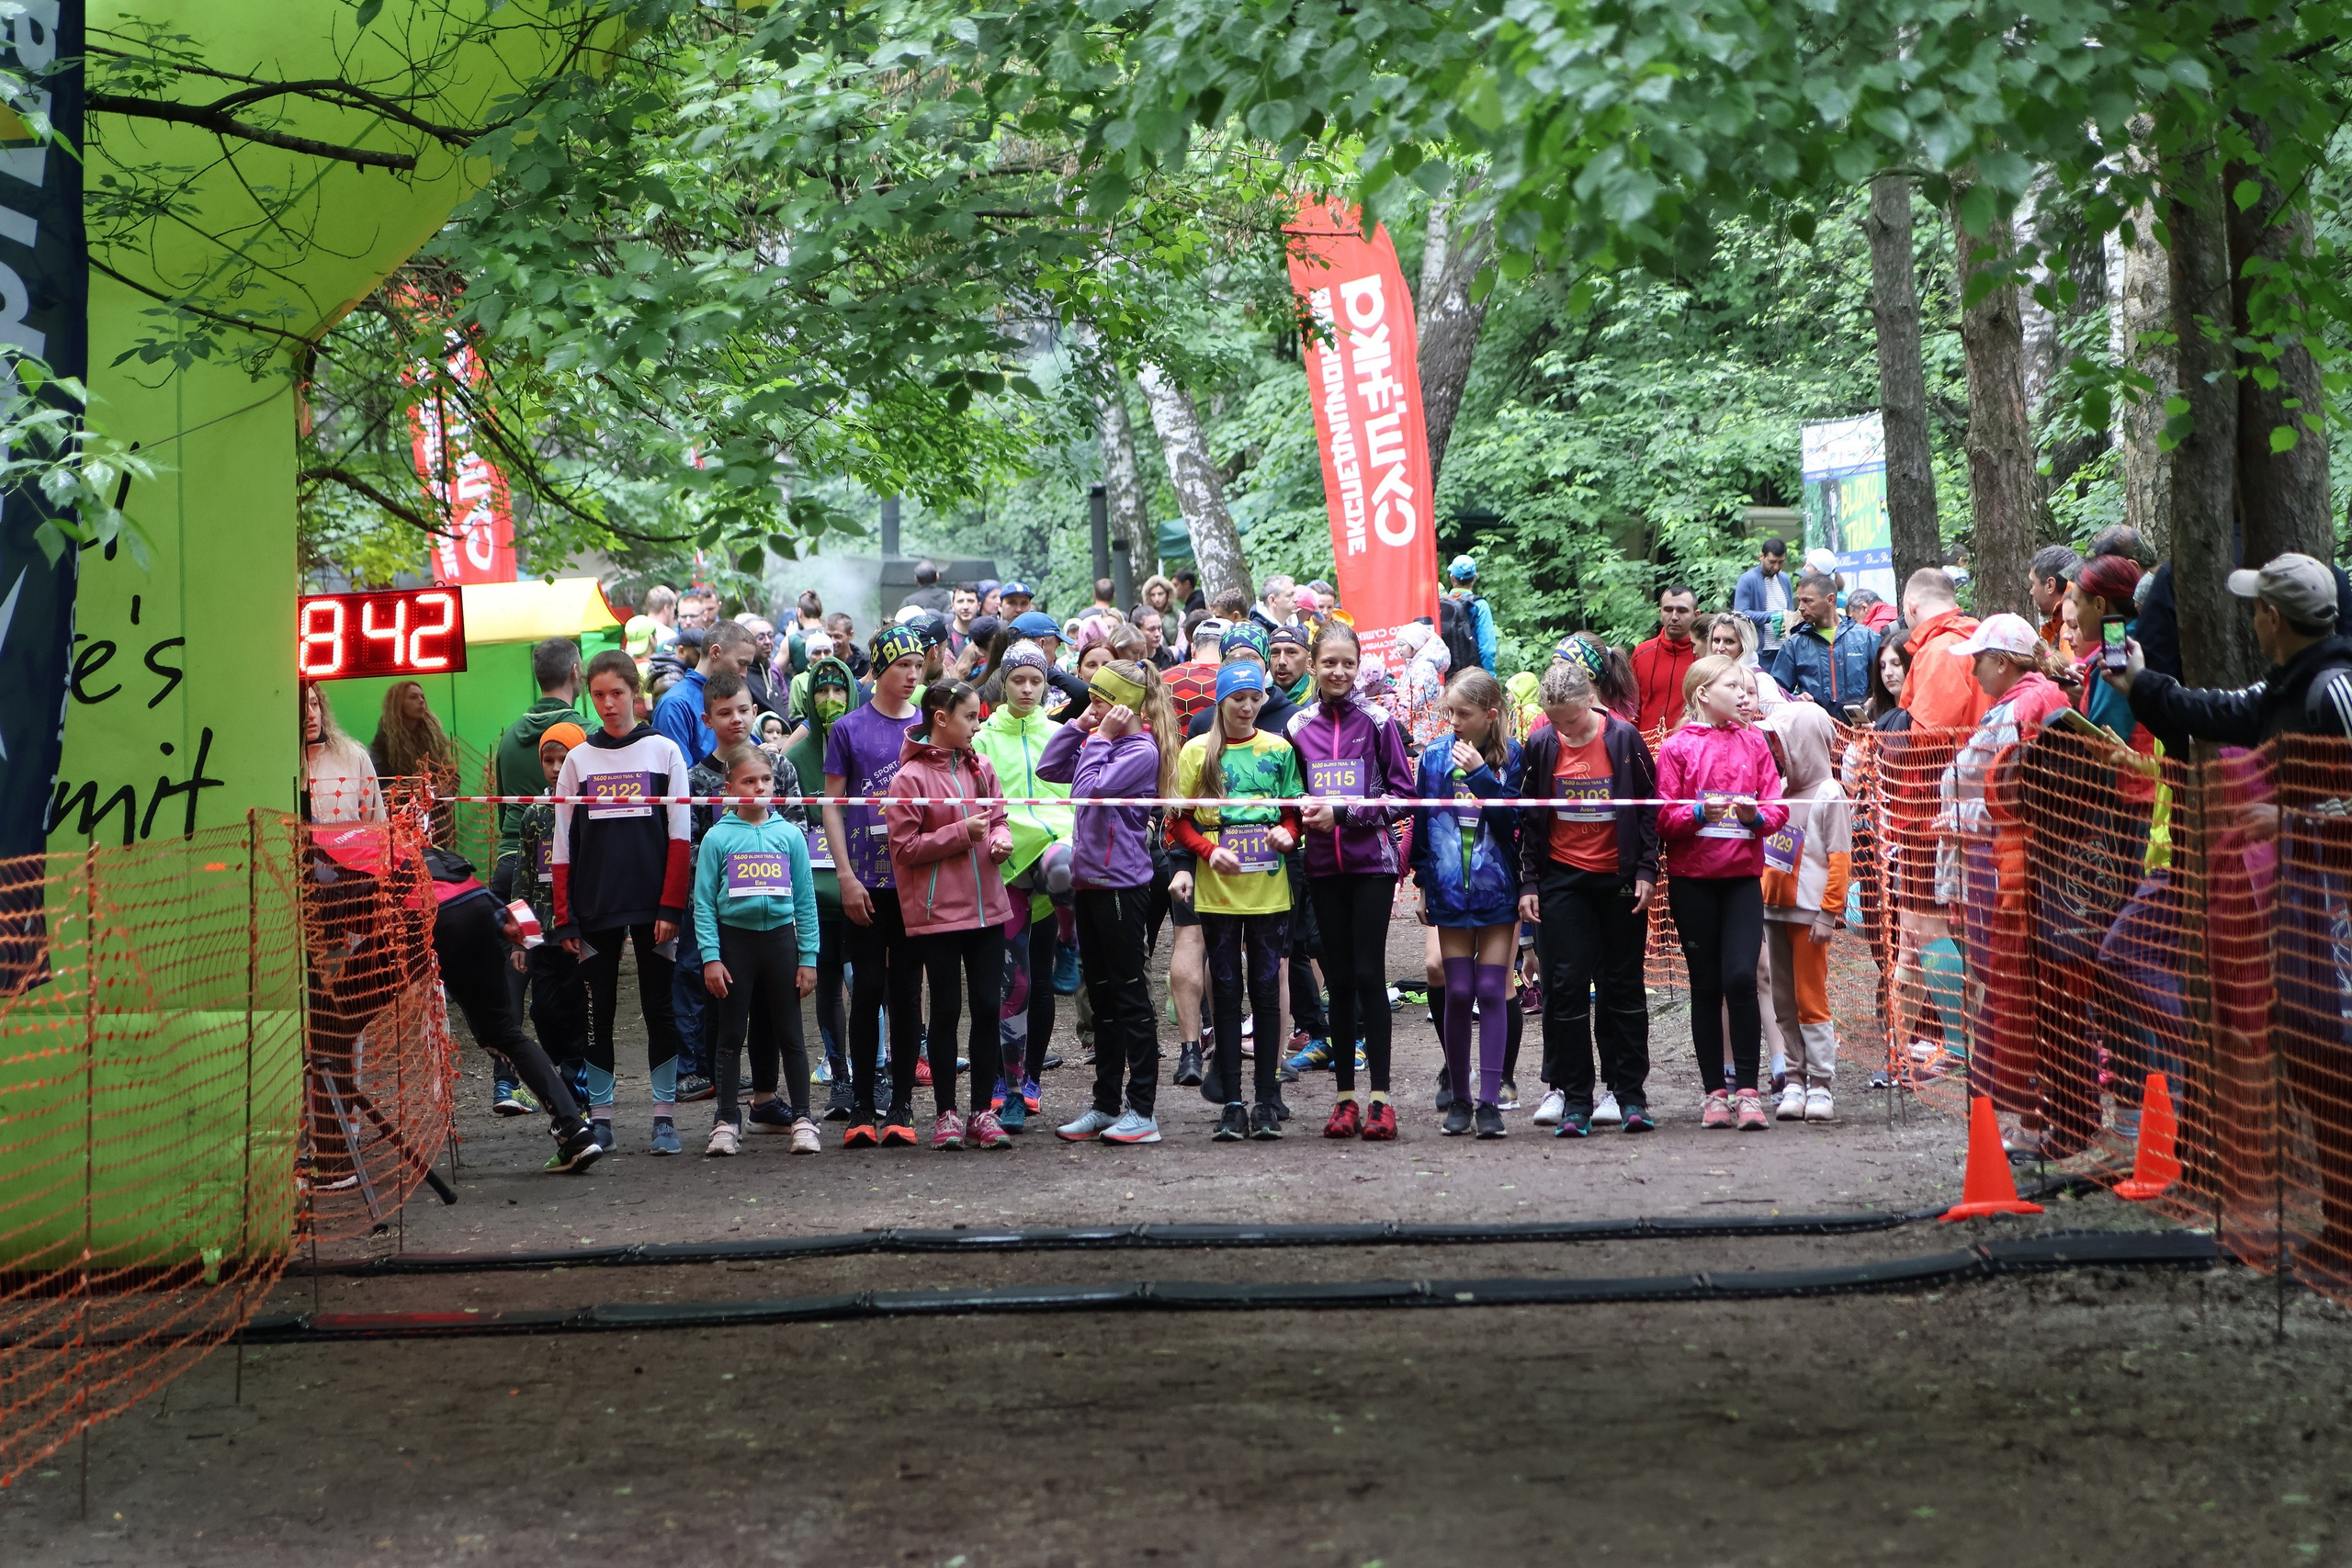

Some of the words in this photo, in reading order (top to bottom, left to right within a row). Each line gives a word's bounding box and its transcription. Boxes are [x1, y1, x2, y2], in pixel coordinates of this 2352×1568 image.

[1840, 471, 1879, 522] BLIZKO
[1845, 512, 1877, 553] TRAIL
[1314, 771, 1355, 788] 2115
[596, 783, 642, 797] 2122
[1565, 788, 1611, 800] 2103
[1227, 837, 1269, 854] 2111
[1765, 832, 1793, 853] 2129
[737, 863, 783, 878] 2008
